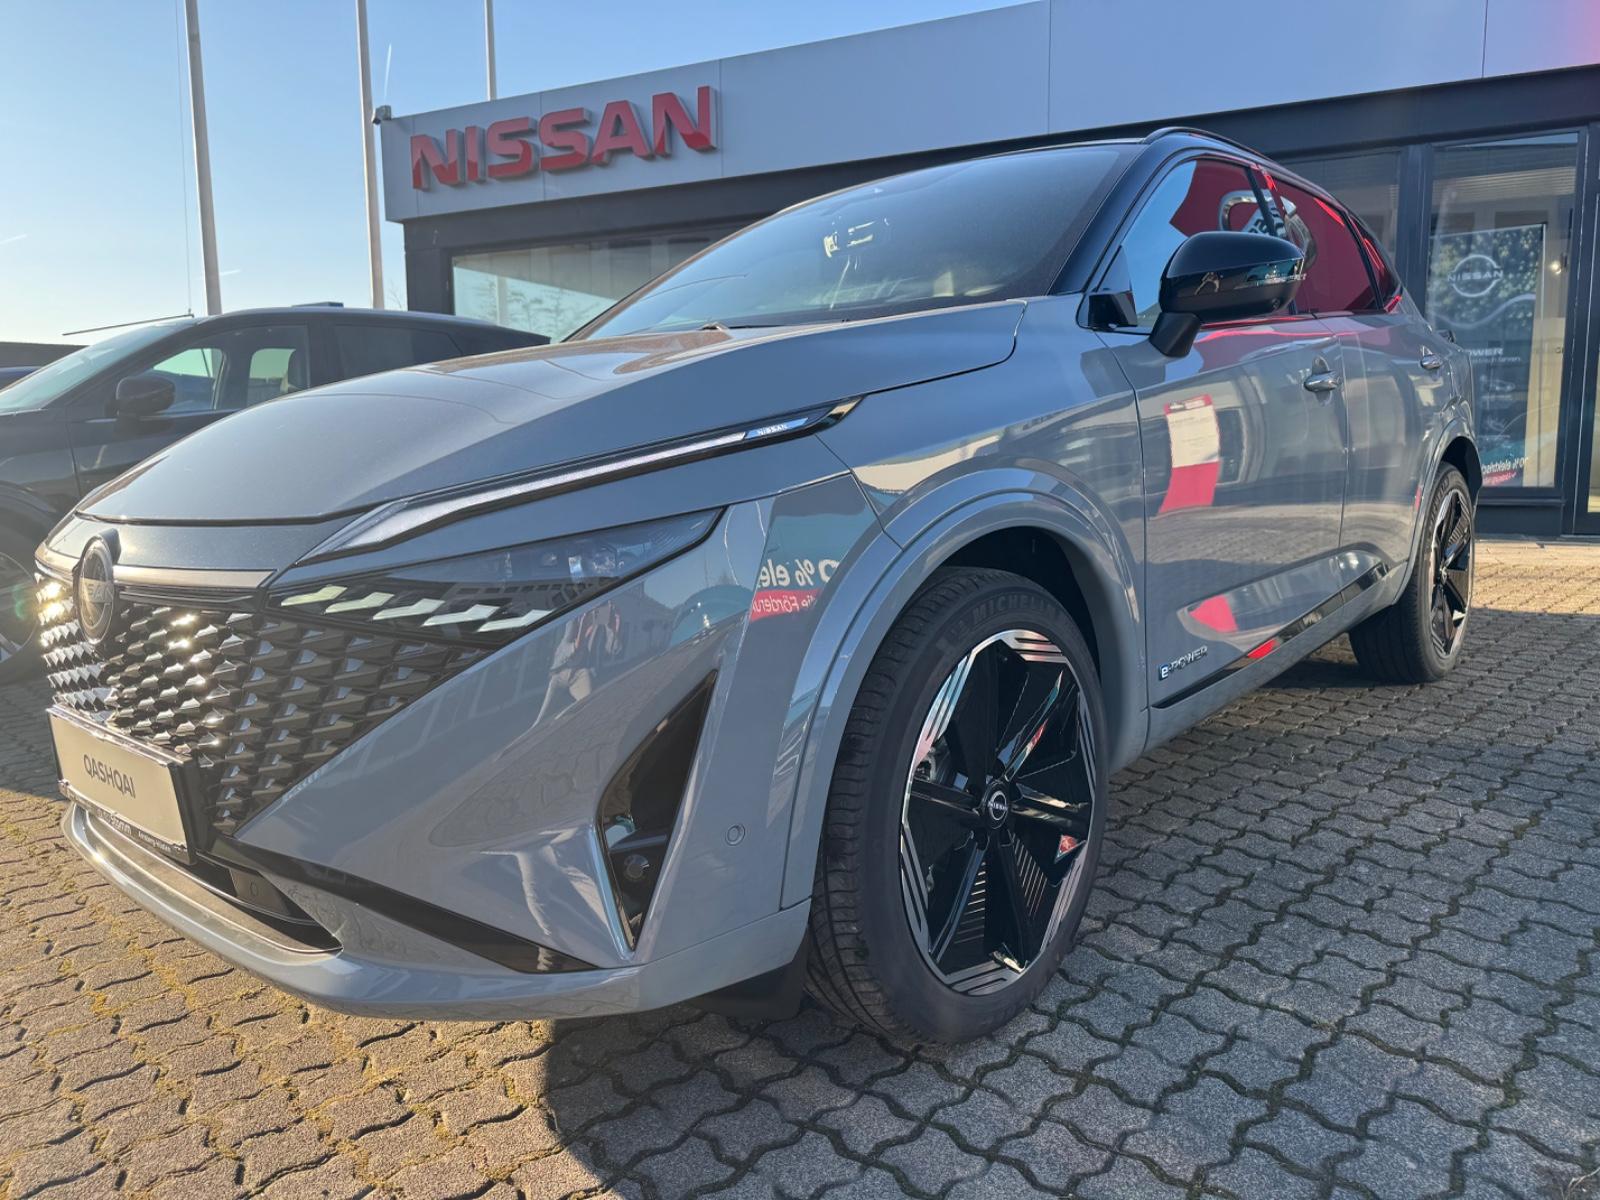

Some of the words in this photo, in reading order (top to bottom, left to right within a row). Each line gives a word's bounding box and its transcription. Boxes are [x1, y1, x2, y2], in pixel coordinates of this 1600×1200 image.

[410, 85, 716, 190] NISSAN
[972, 594, 1059, 621] MICHELIN
[83, 754, 136, 799] QASHQAI
